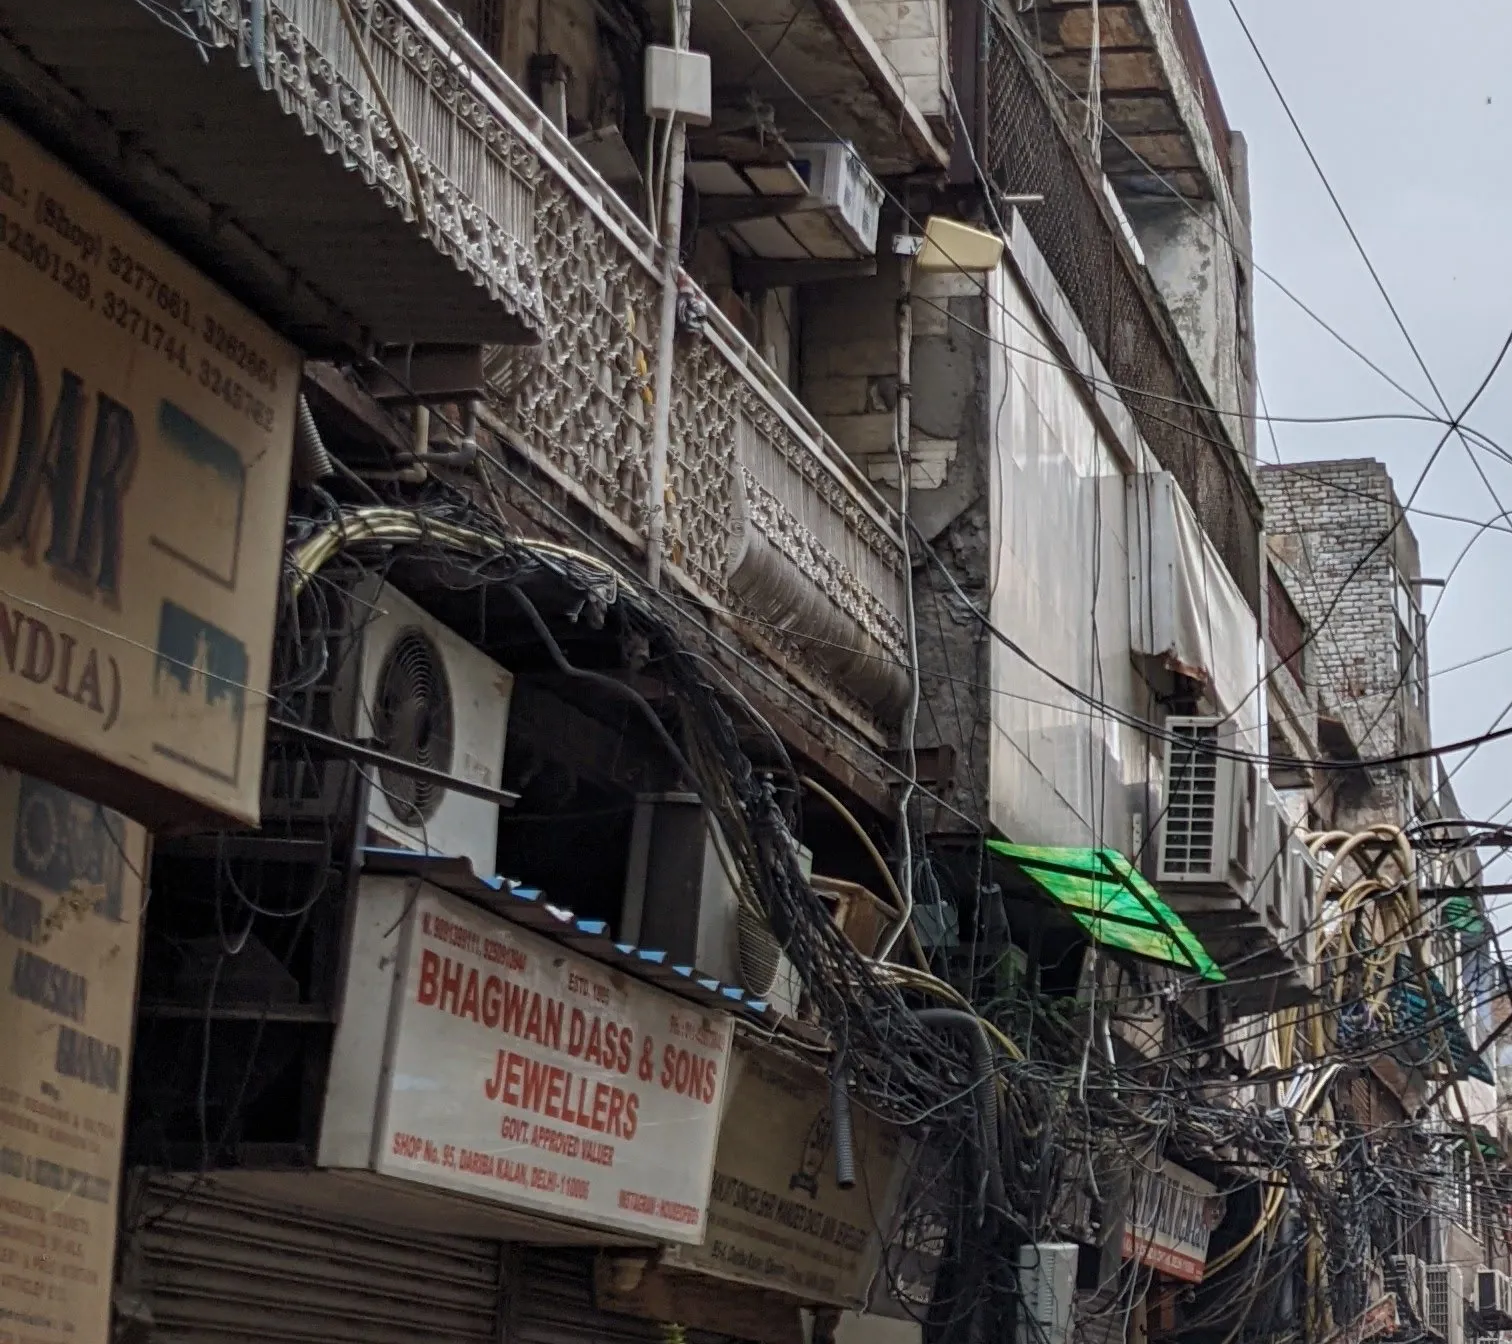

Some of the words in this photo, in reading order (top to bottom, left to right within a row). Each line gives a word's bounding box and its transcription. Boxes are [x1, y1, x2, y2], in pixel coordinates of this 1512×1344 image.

[418, 948, 563, 1051] BHAGWAN
[568, 1006, 634, 1075] DASS
[638, 1035, 655, 1083] &
[660, 1042, 718, 1105] SONS
[484, 1049, 640, 1141] JEWELLERS
[393, 1131, 422, 1157] SHOP
[532, 1123, 581, 1157] APPROVED
